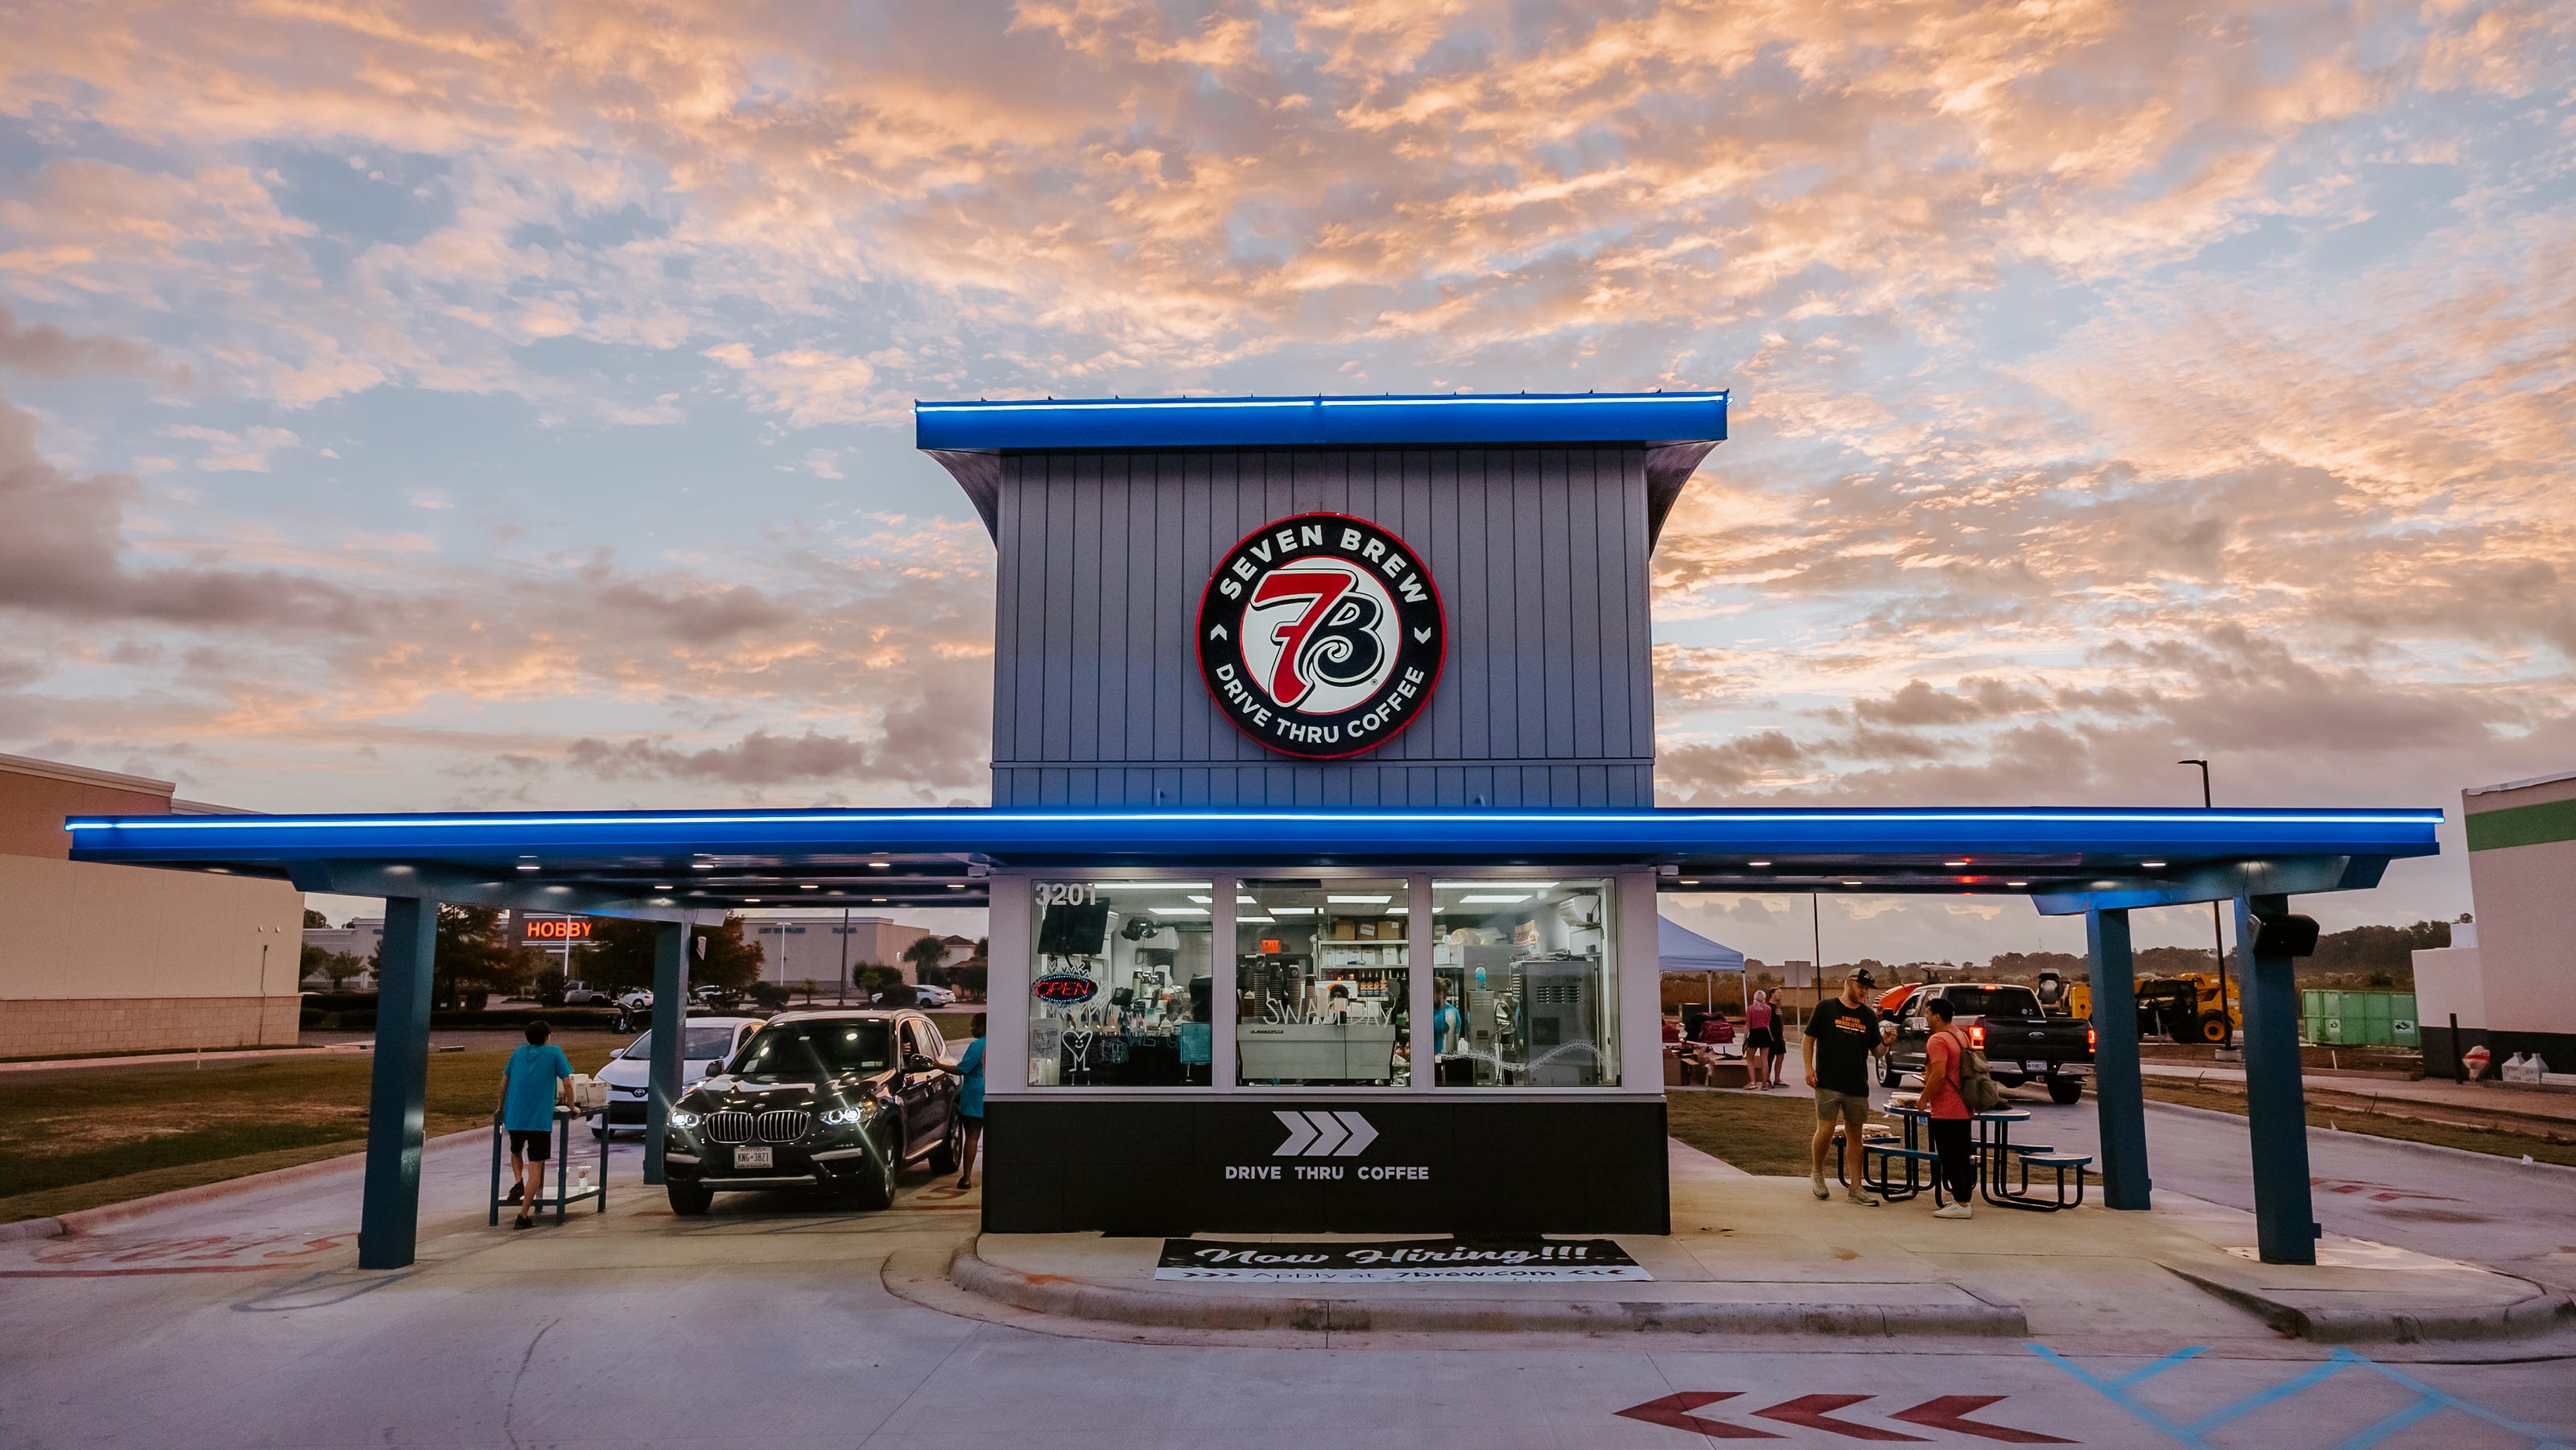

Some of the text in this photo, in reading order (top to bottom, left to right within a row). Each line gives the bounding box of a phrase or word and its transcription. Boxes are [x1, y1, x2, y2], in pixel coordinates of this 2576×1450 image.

[1220, 525, 1427, 603] SEVEN BREW
[1216, 663, 1424, 743] DRIVE THRU COFFEE
[1035, 883, 1096, 906] 3201
[527, 921, 592, 937] HOBBY
[1035, 981, 1090, 996] OPEN
[1225, 1167, 1429, 1179] DRIVE THRU COFFEE
[1194, 1246, 1588, 1264] Now Hiring!!!
[1397, 1270, 1557, 1279] 7brew.com
